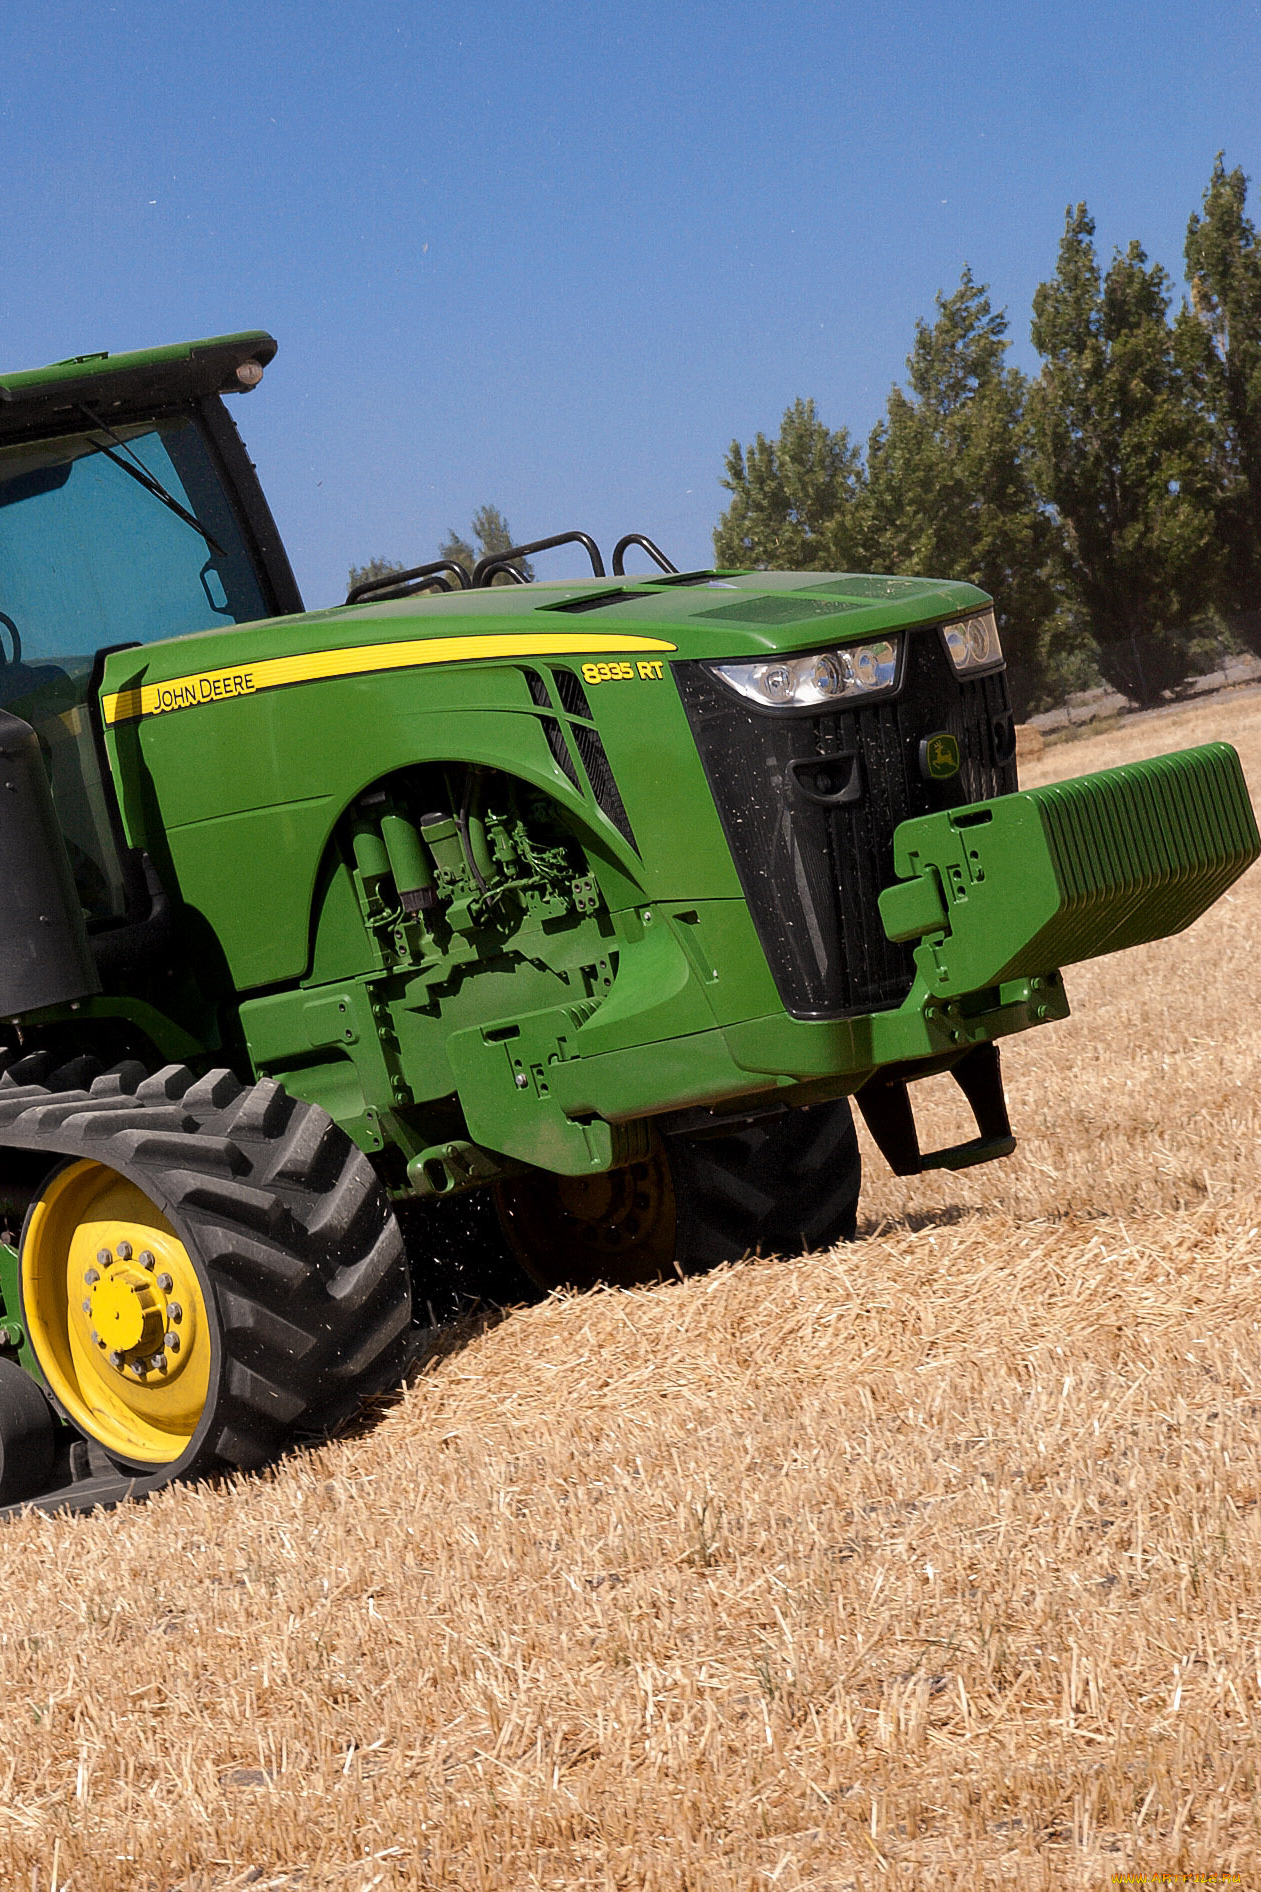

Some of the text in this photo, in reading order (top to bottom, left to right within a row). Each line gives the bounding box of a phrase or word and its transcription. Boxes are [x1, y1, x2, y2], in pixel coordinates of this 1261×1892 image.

[581, 661, 664, 685] 8335 RT
[154, 673, 255, 710] JOHN DEERE
